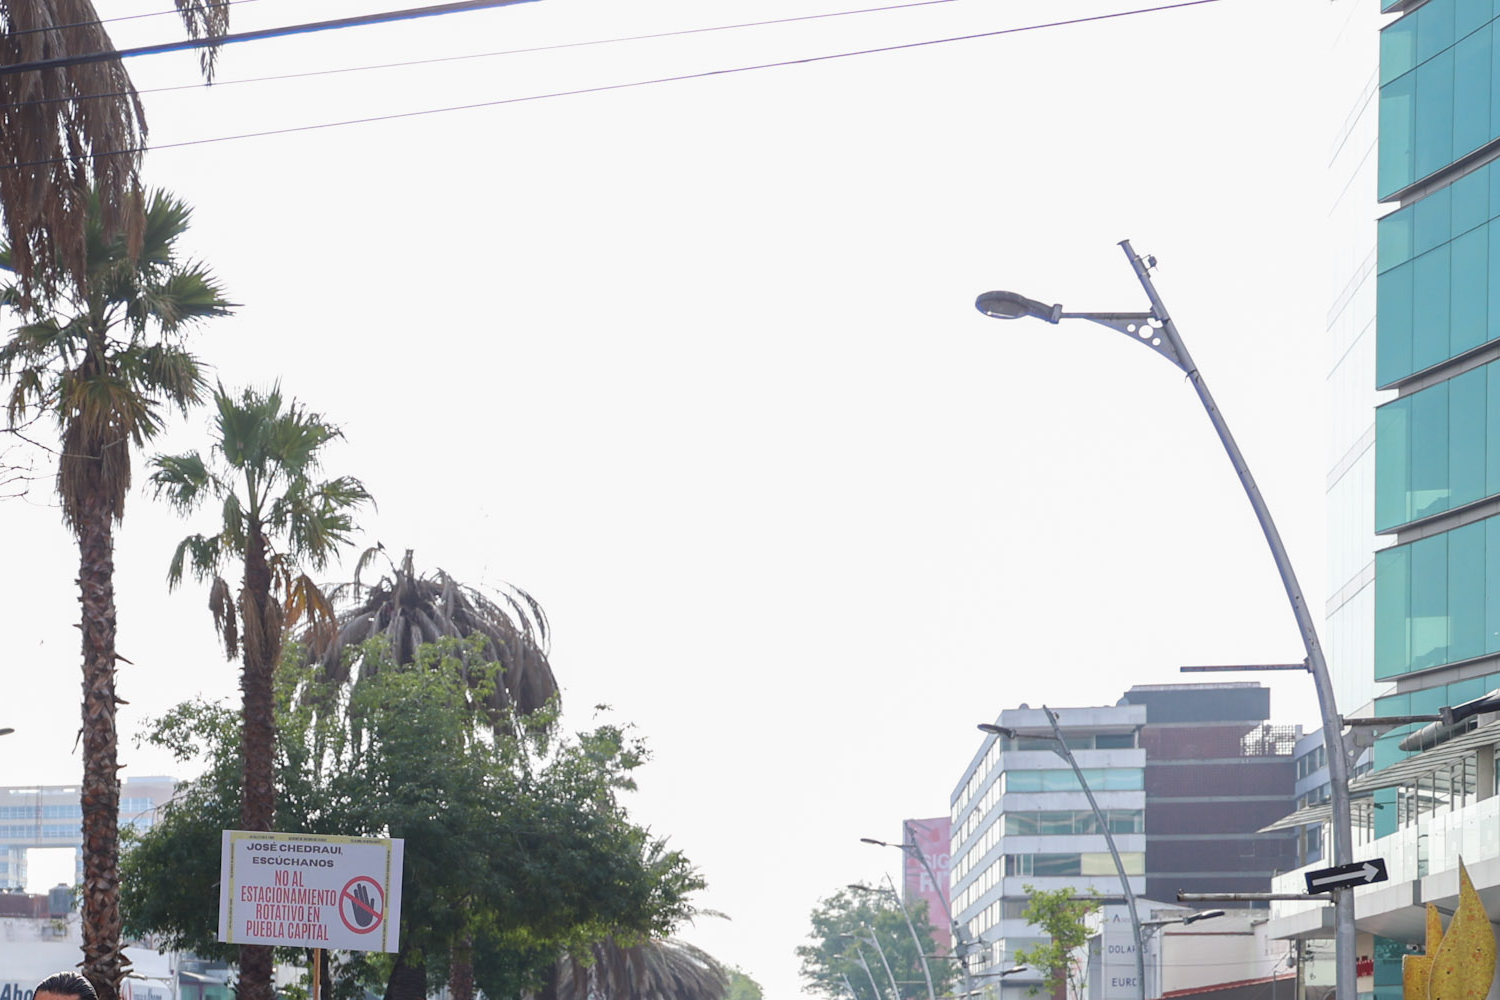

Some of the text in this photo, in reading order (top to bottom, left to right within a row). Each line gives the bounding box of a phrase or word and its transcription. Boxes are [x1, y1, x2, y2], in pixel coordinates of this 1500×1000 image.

[246, 842, 343, 856] JOSÉ CHEDRAUI,
[274, 870, 304, 888] NO AL
[241, 885, 337, 907] ESTACIONAMIENTO
[255, 904, 320, 923] ROTATIVO EN
[246, 920, 329, 941] PUEBLA CAPITAL
